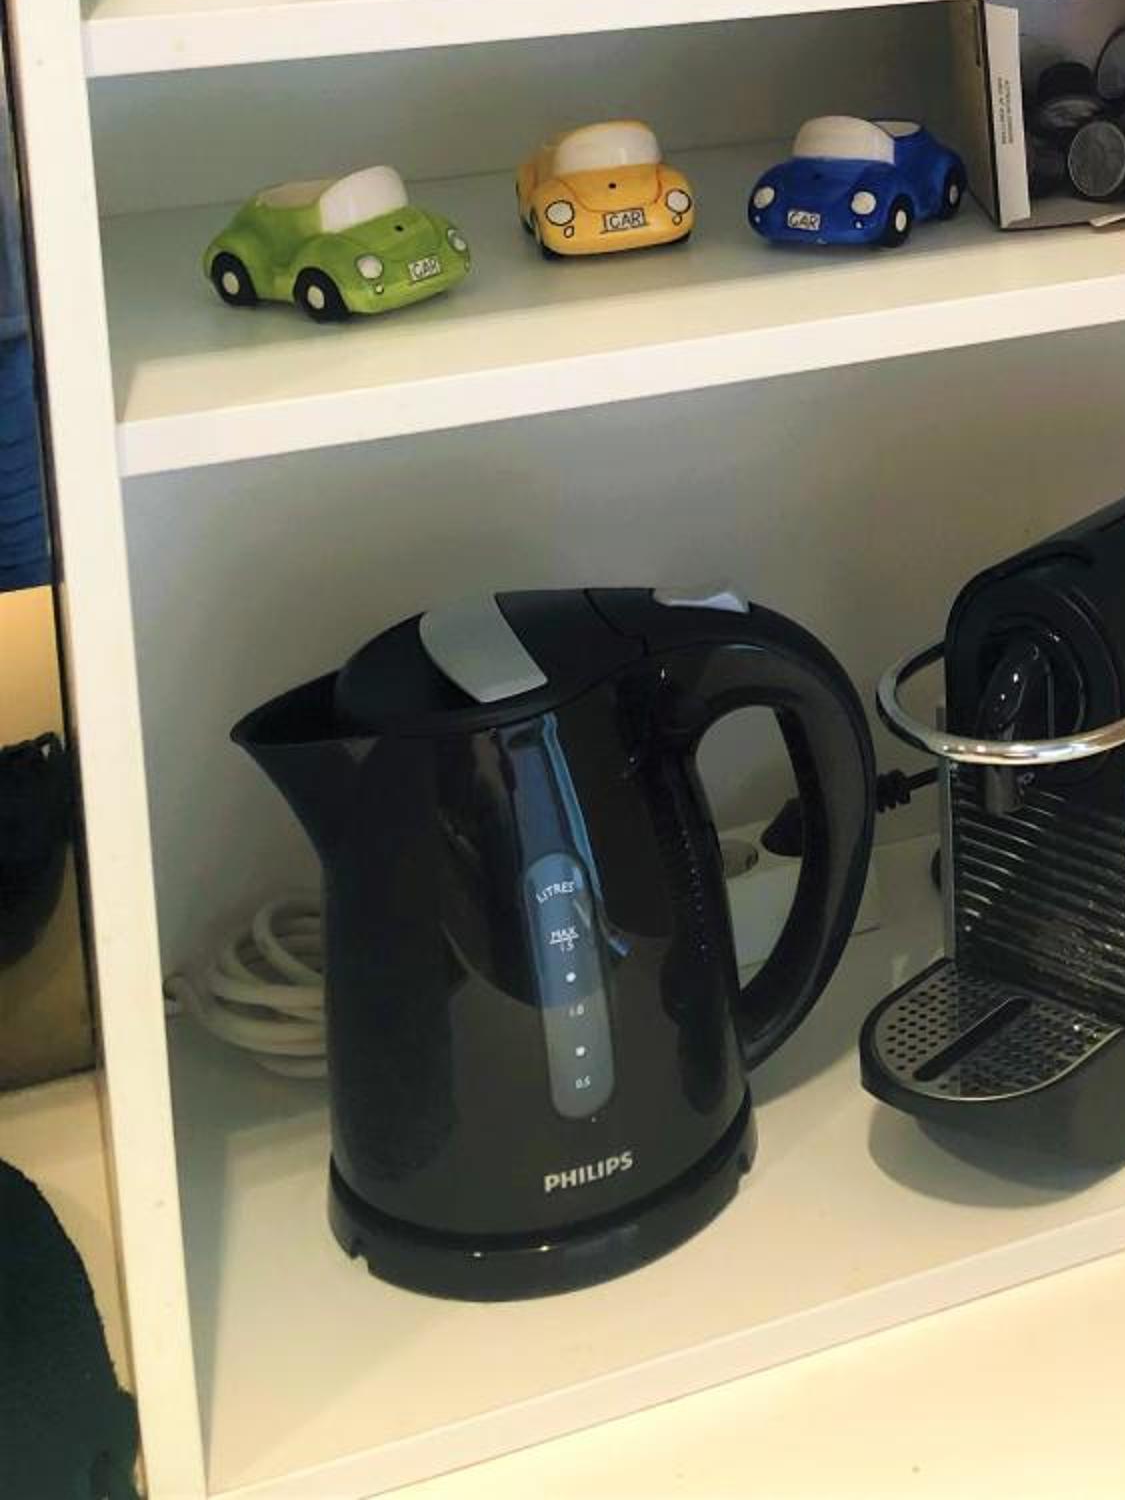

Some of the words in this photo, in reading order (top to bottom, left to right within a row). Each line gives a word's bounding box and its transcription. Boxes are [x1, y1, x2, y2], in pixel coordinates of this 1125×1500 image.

[609, 210, 641, 229] CAR
[789, 211, 818, 229] CAR
[411, 258, 440, 279] CAR
[536, 880, 576, 904] LITRES
[551, 926, 578, 941] MAX
[575, 1076, 592, 1090] 0.5
[544, 1151, 634, 1193] PHILIPS
